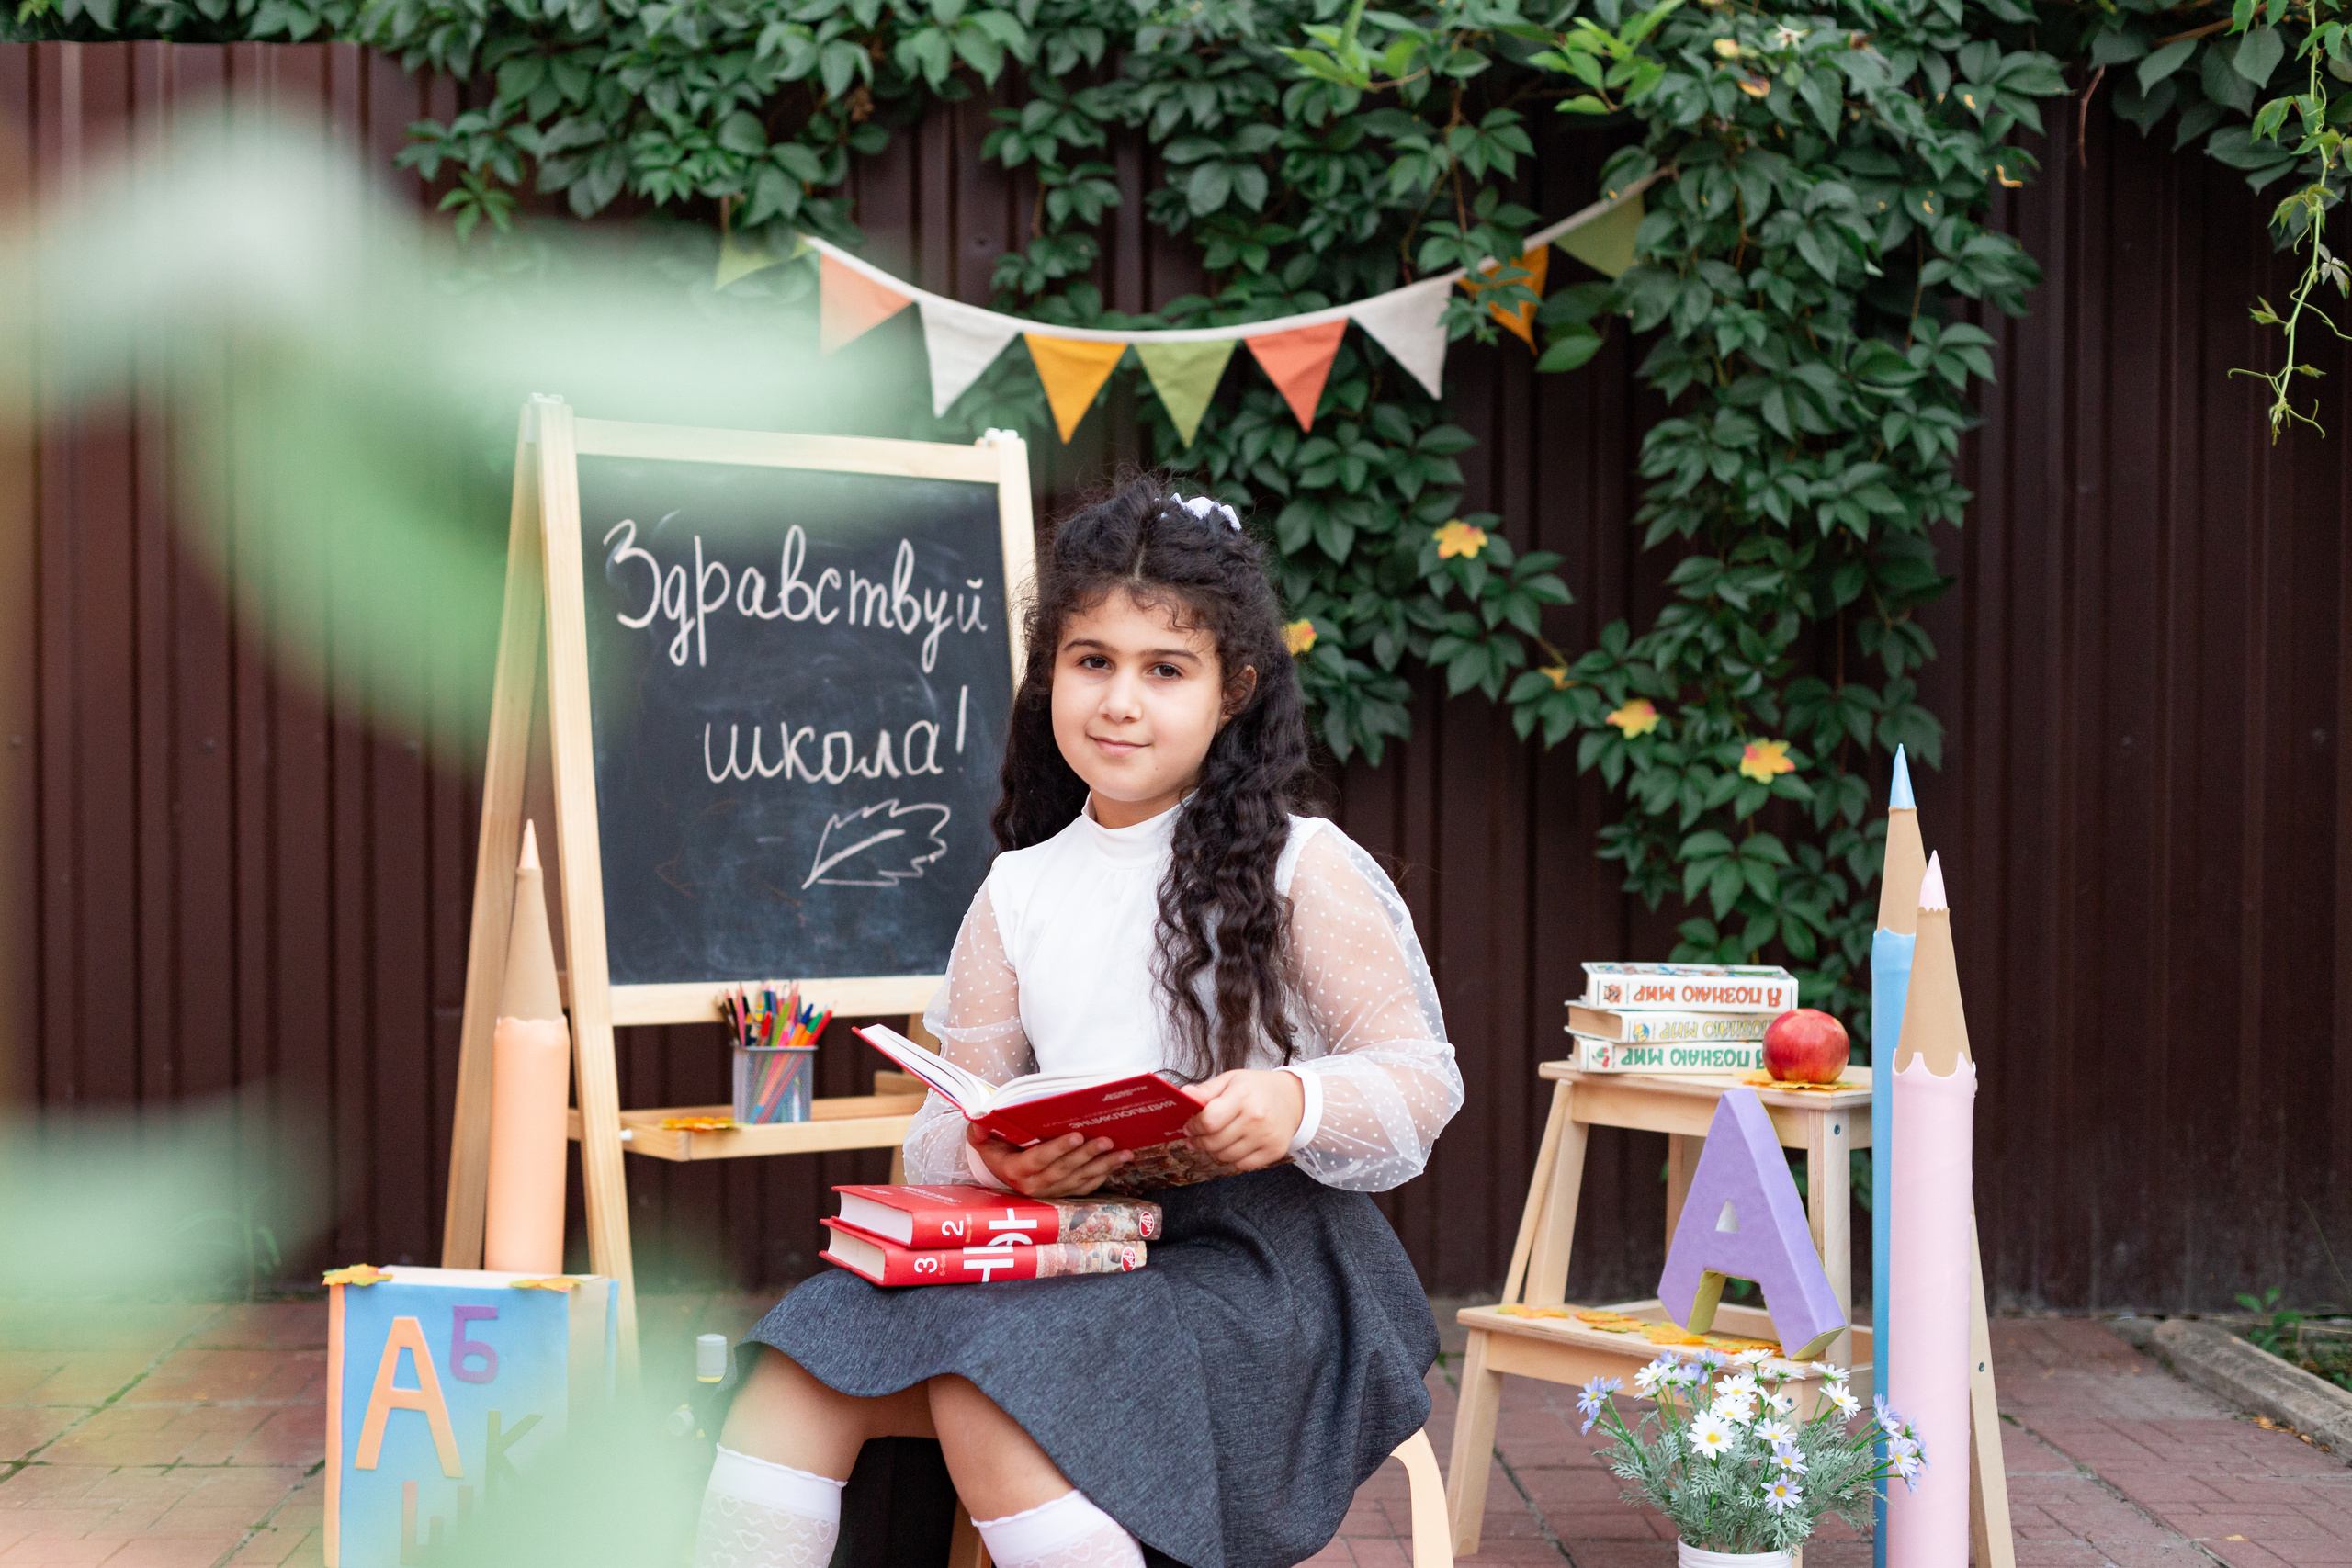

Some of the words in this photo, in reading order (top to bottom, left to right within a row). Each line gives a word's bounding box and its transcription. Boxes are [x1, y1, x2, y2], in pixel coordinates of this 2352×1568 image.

[603, 519, 989, 674] Здравствуй
[704, 684, 969, 784] школа!
[1633, 985, 1675, 1002] МИР
[1682, 985, 1762, 1004] ПОЗНАЮ
[1767, 987, 1782, 1008] Я
[1659, 1021, 1698, 1039] МИР
[1620, 1047, 1664, 1066] МИР
[1670, 1048, 1750, 1067] ПОЗНАЮ
[941, 1220, 964, 1236] 2
[913, 1257, 938, 1273] 3
[449, 1305, 499, 1384] Б
[355, 1315, 464, 1479] А
